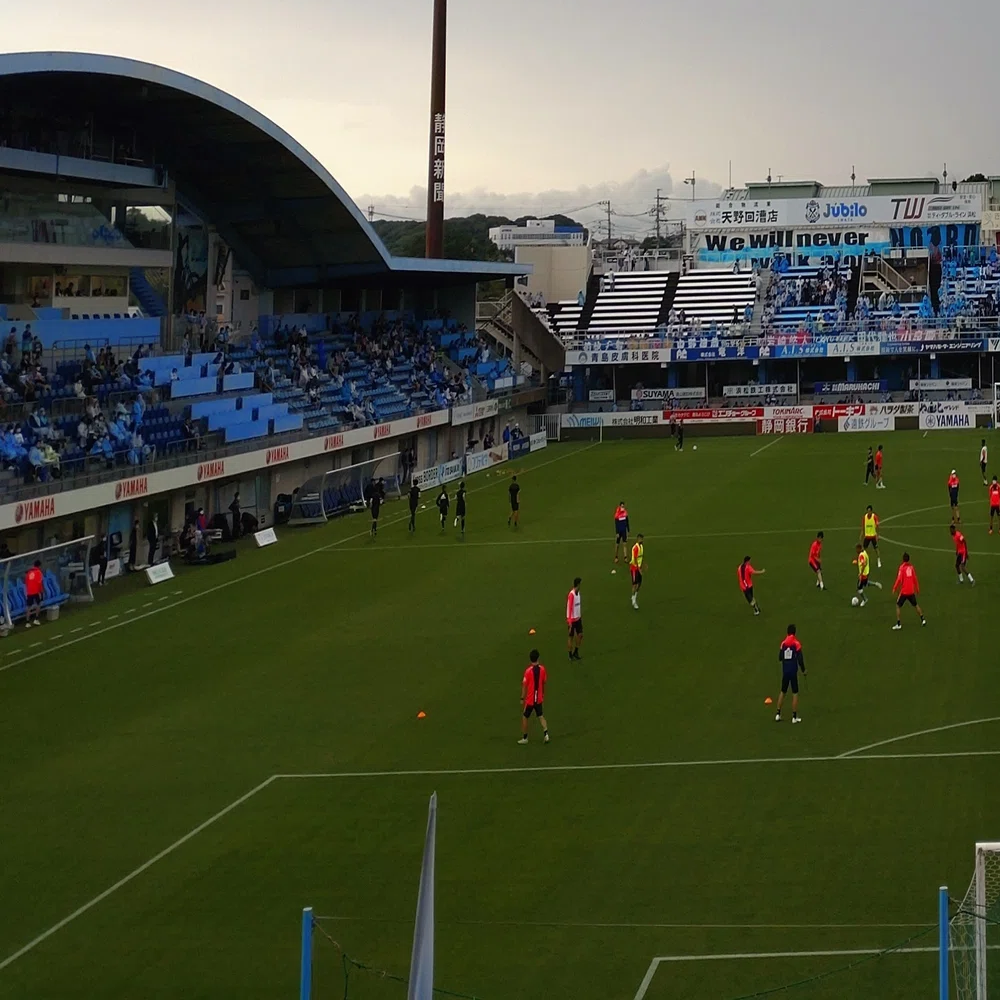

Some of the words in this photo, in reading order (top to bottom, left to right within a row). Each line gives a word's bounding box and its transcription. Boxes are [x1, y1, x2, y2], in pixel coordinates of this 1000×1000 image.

[722, 209, 778, 224] 天野回漕店
[705, 234, 745, 251] We
[749, 230, 793, 249] will
[796, 231, 869, 248] never
[643, 390, 675, 398] SUYAMA
[837, 382, 880, 391] MARUHACHI
[762, 419, 808, 433] 静岡銀行
[936, 414, 969, 427] YAMAHA
[271, 446, 289, 462] YAMAHA
[203, 460, 225, 479] YAMAHA
[122, 477, 148, 498] YAMAHA
[24, 497, 55, 521] YAMAHA
